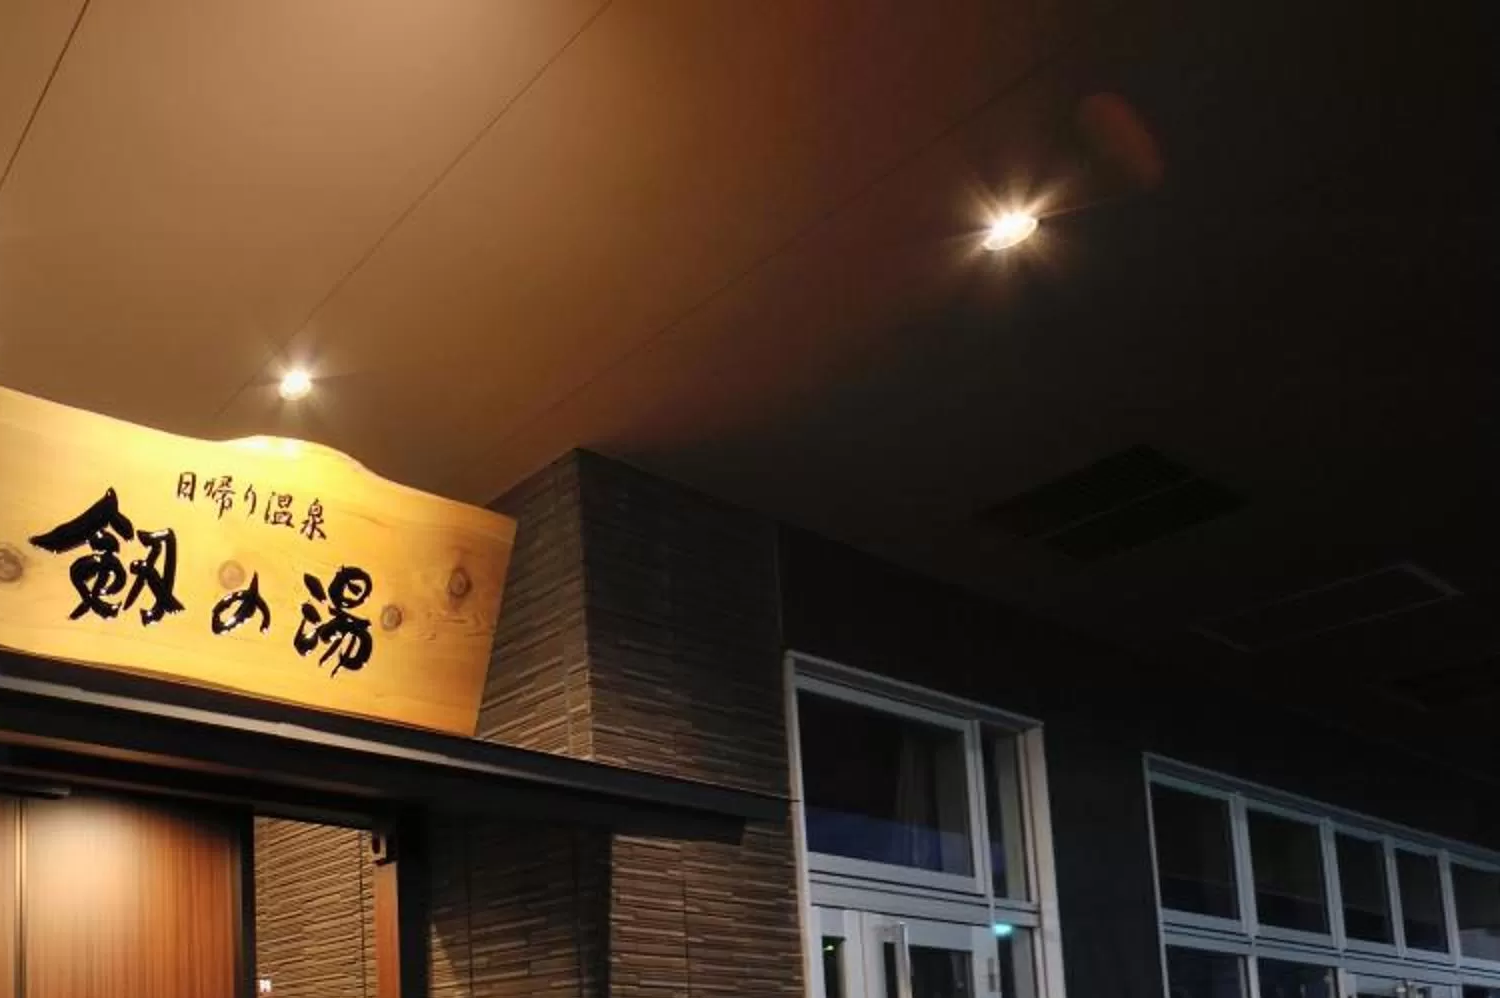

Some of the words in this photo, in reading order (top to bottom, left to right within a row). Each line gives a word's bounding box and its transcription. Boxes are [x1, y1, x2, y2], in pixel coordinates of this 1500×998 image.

[176, 471, 327, 541] 日帰り温泉
